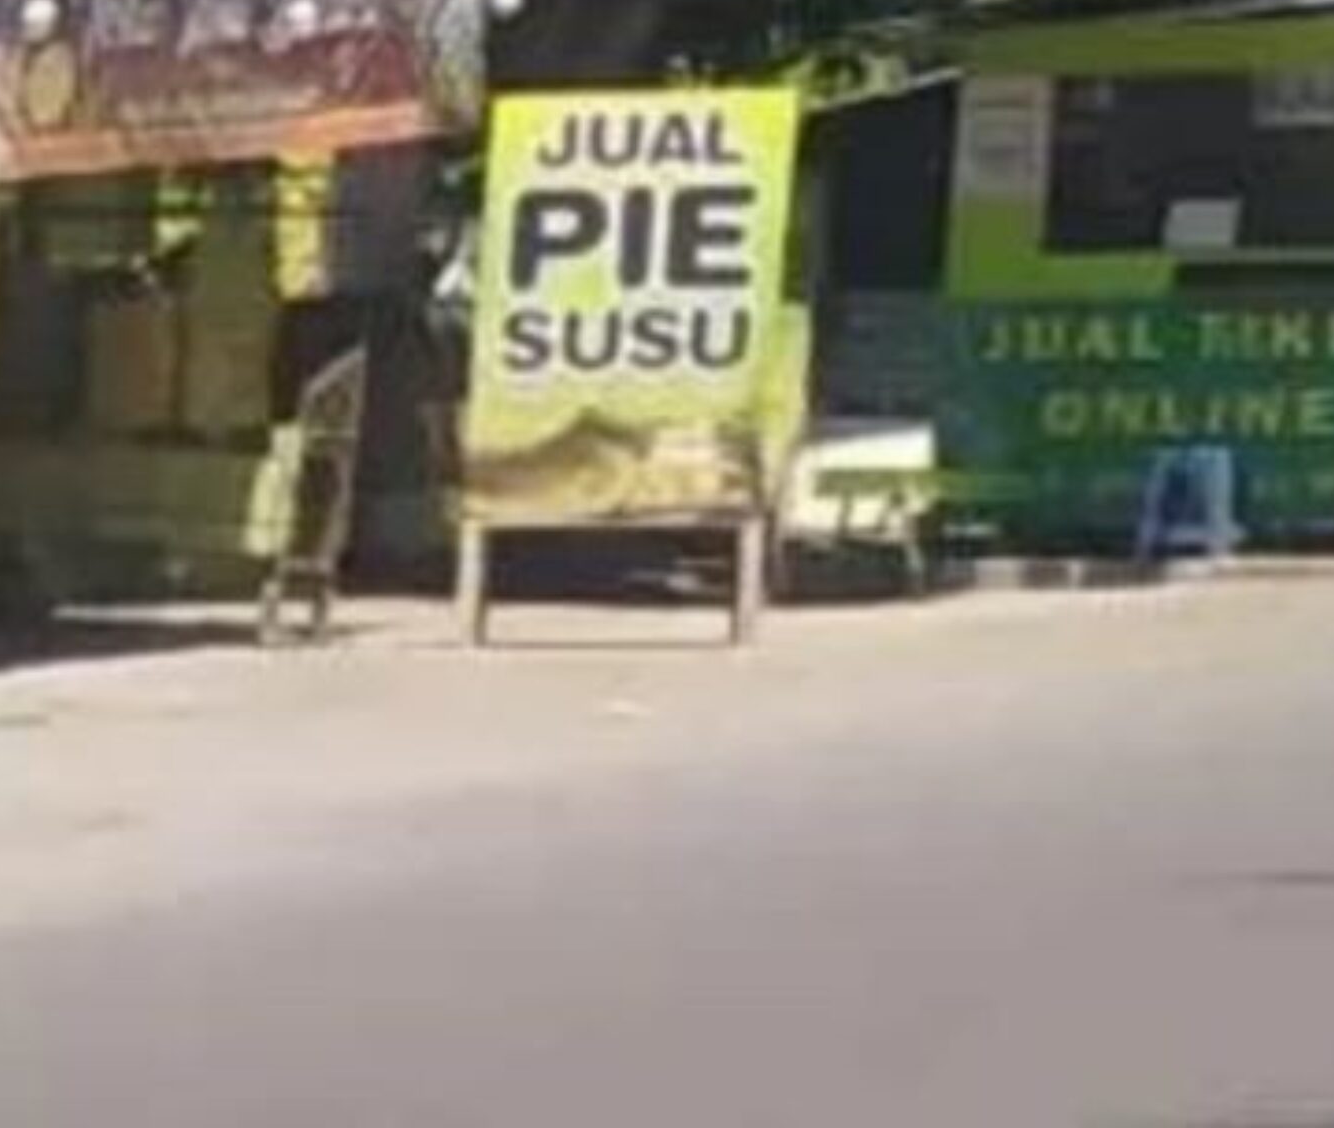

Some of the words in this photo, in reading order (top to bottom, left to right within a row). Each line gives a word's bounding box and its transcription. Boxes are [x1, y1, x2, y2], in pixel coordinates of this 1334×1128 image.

[536, 112, 744, 168] JUAL
[509, 185, 757, 291] PIE
[502, 308, 751, 370] SUSU
[981, 314, 1163, 361] JUAL
